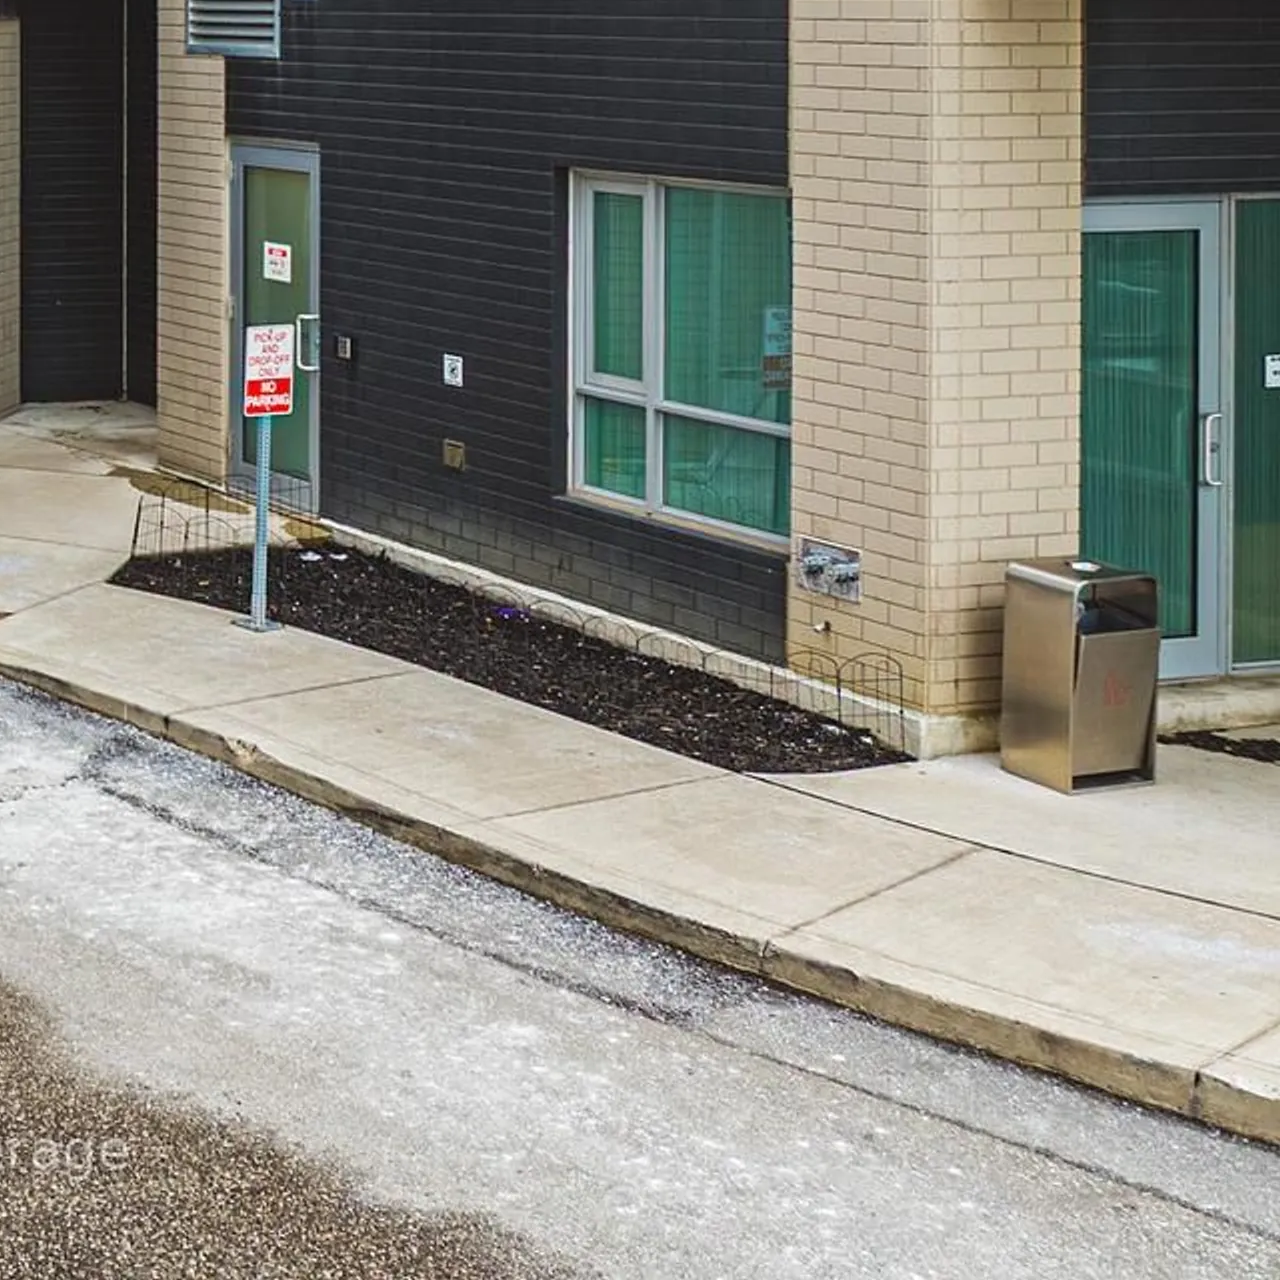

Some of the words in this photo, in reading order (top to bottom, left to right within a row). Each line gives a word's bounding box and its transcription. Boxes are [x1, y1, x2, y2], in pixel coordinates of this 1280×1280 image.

[262, 343, 279, 353] AND
[260, 380, 277, 393] NO
[245, 393, 290, 406] PARKING
